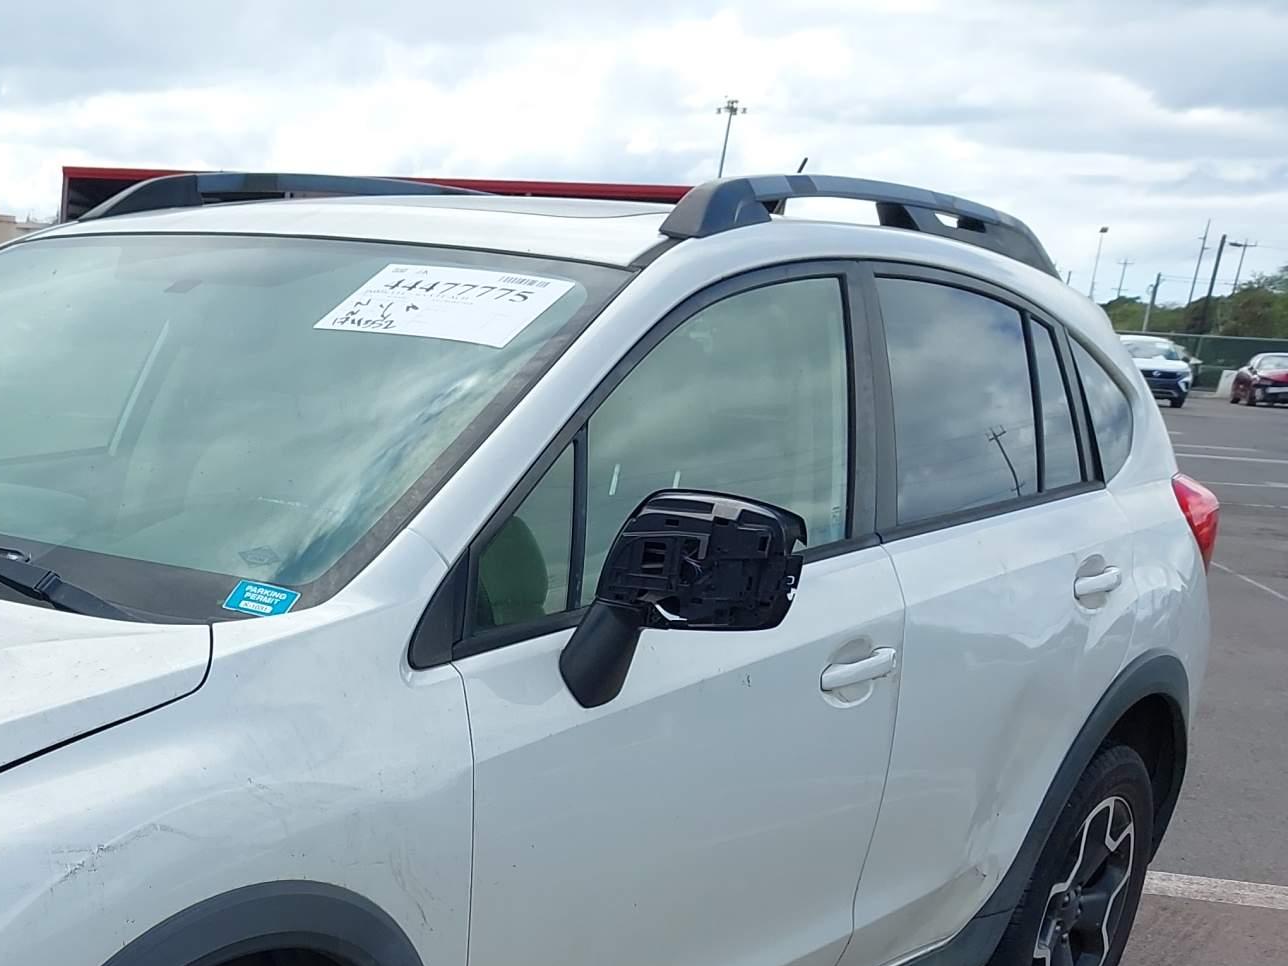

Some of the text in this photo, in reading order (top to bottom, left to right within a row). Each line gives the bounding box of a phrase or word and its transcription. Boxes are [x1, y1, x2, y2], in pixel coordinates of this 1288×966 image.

[384, 279, 535, 302] 44477775
[244, 592, 281, 605] PERMIT
[245, 585, 288, 600] PARKING
